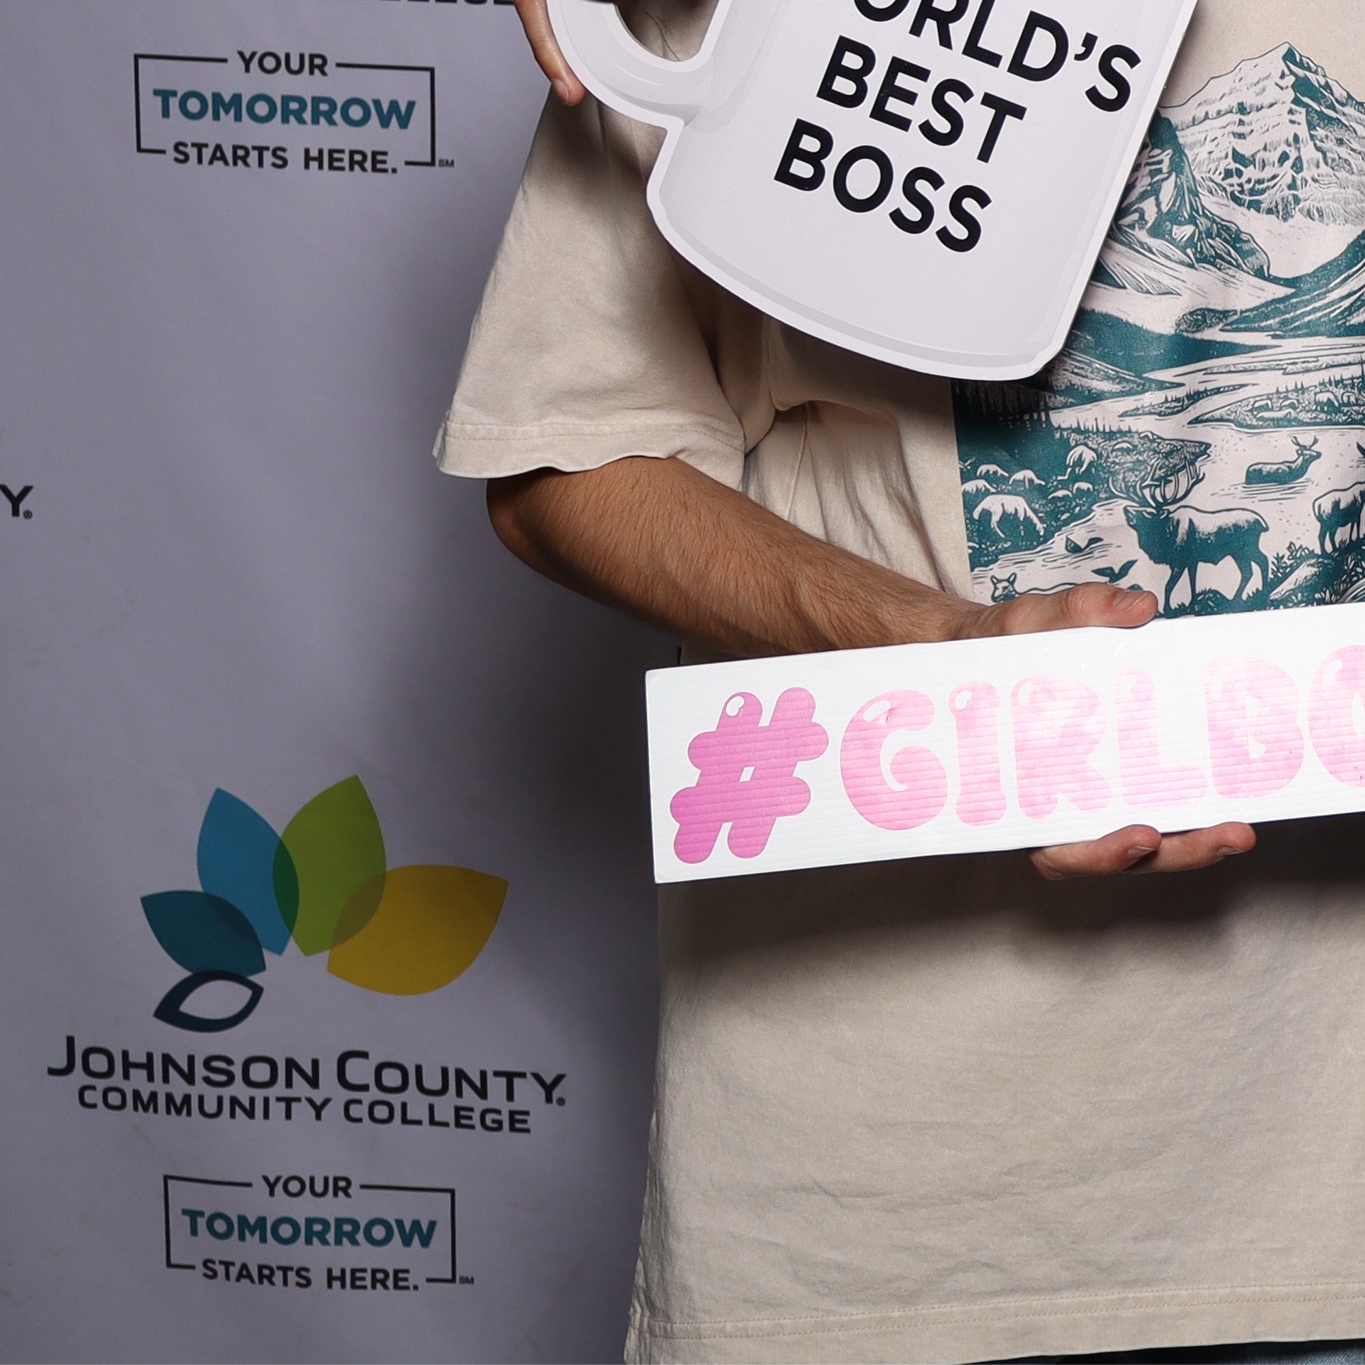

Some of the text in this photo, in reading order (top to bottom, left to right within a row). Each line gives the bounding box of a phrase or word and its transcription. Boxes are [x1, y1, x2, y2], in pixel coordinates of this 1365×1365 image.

[237, 50, 328, 76] YOUR
[153, 89, 416, 130] TOMORROW
[816, 34, 1026, 164] BEST
[173, 140, 289, 169] STARTS
[304, 148, 398, 174] HERE.
[774, 118, 992, 253] BOSS
[47, 1035, 320, 1090] JOHNSON
[78, 1084, 531, 1134] COMMUNITY COLLEGE
[261, 1174, 352, 1198] YOUR
[181, 1208, 437, 1249] TOMORROW
[202, 1258, 311, 1289] STARTS
[326, 1267, 419, 1291] HERE.
